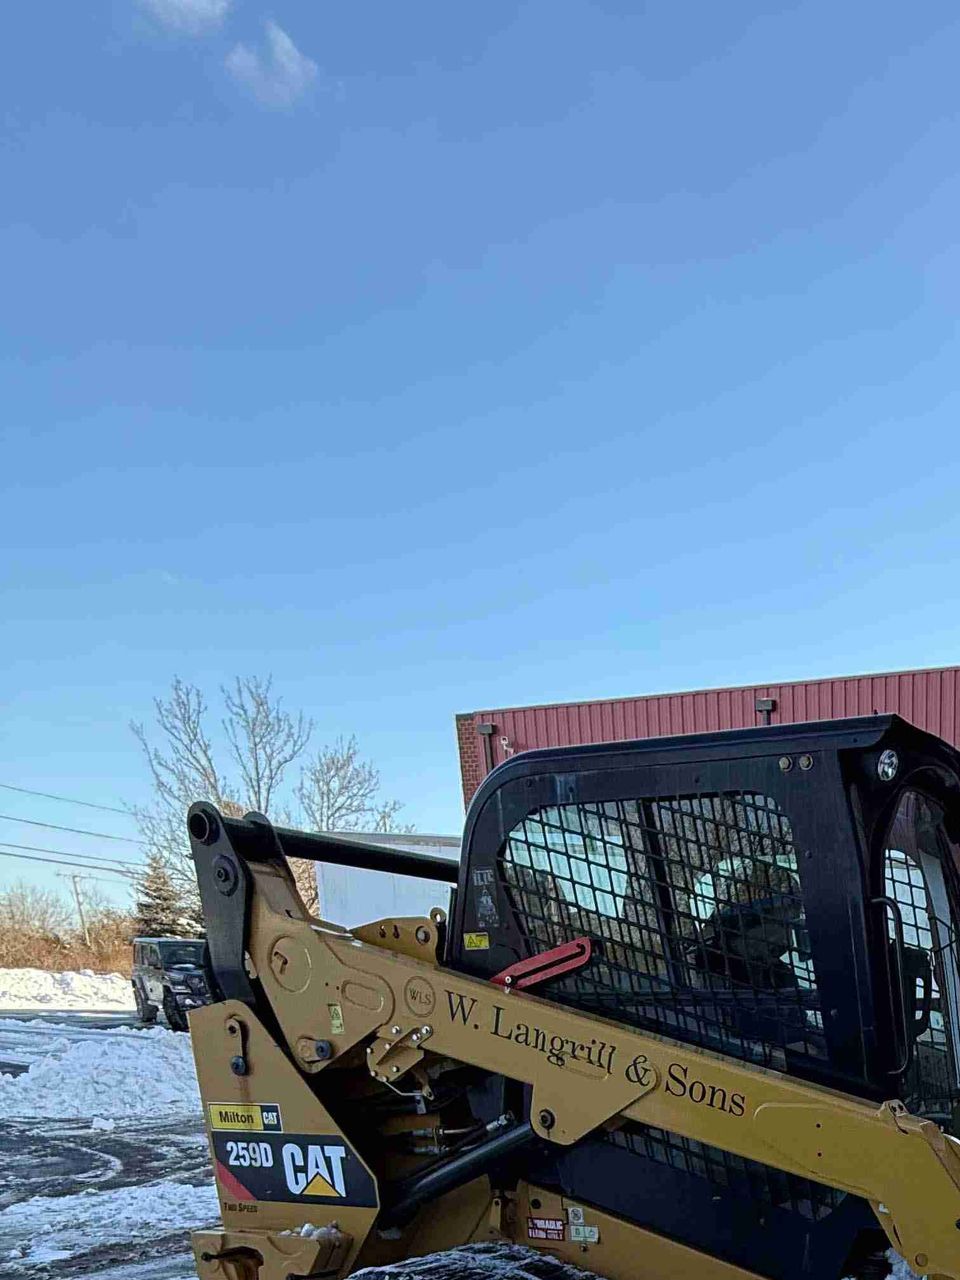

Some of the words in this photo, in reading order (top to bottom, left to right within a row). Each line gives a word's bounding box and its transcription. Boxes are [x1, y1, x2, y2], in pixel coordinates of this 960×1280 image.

[409, 987, 432, 1006] WLS
[444, 989, 479, 1030] W.
[490, 1005, 617, 1075] Langrill
[625, 1054, 651, 1087] &
[665, 1063, 746, 1117] Sons
[219, 1111, 254, 1124] Milton
[262, 1112, 278, 1125] CAT
[226, 1141, 274, 1168] 259D
[281, 1143, 347, 1198] CAT
